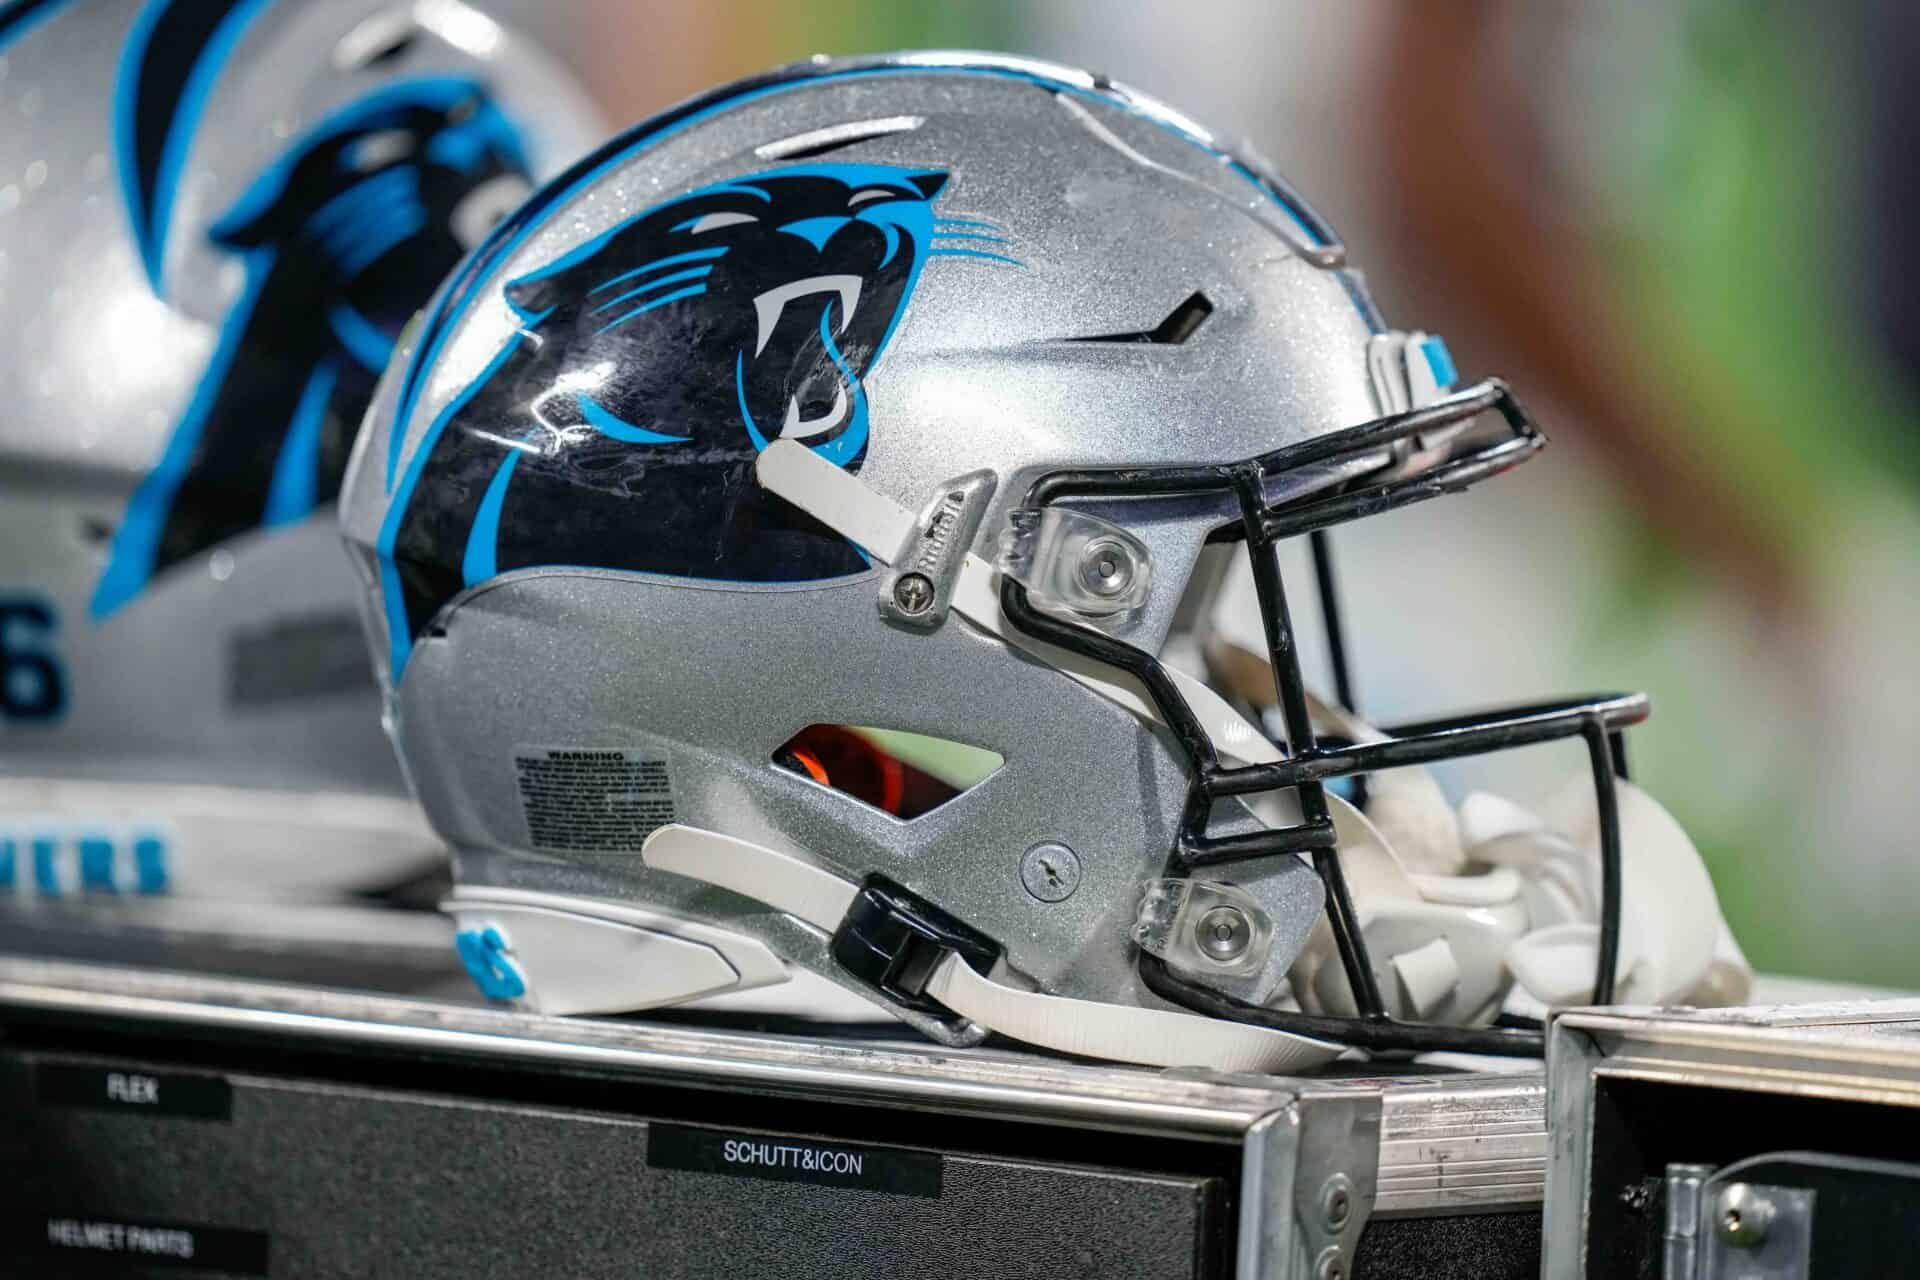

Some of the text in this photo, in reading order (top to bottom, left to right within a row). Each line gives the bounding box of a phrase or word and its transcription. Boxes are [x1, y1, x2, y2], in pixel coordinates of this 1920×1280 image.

[547, 751, 625, 761] WARNING
[106, 1072, 160, 1104] FLEX
[723, 1140, 863, 1175] SCHUTT&ICON
[47, 1217, 195, 1259] HELMET PARTS
